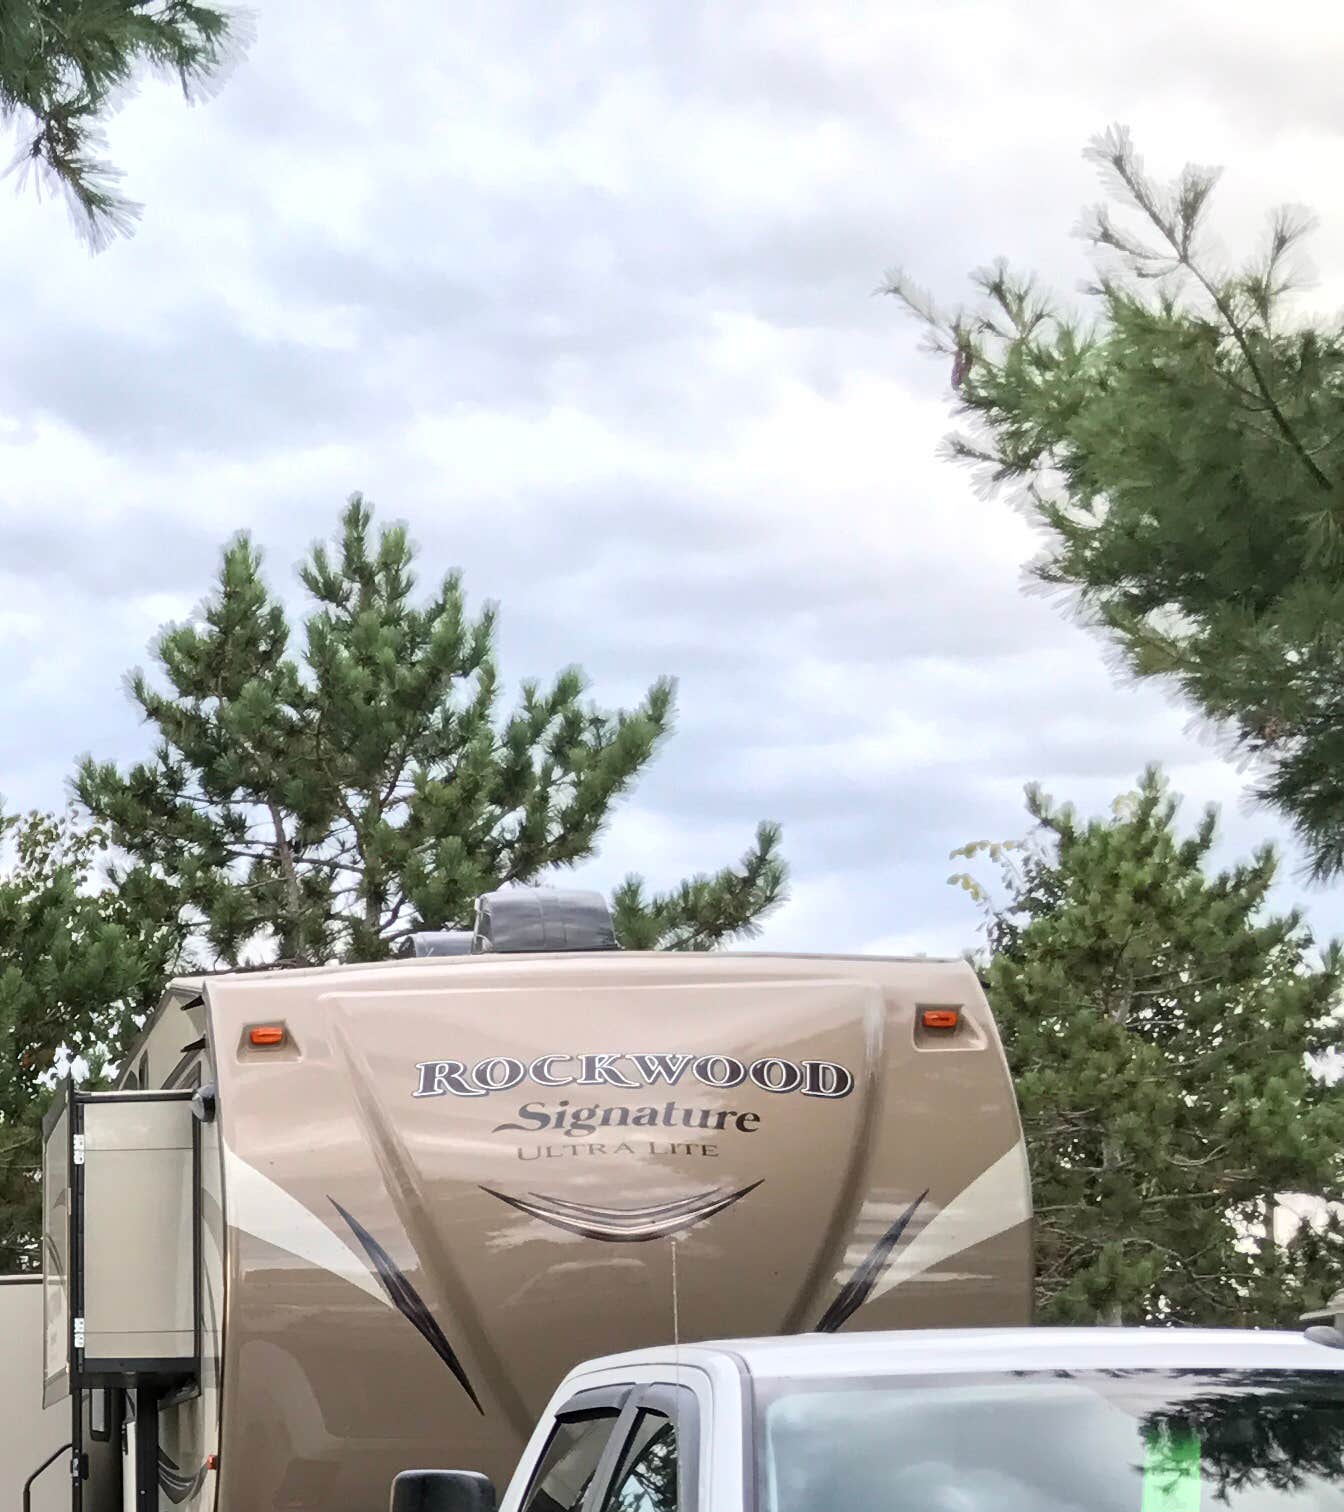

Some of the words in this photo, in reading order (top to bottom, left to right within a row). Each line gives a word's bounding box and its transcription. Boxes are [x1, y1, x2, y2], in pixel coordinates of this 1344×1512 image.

[412, 1053, 854, 1098] ROCKWOOD
[491, 1100, 761, 1137] Signature
[517, 1142, 634, 1161] ULTRA
[649, 1141, 720, 1157] LITE
